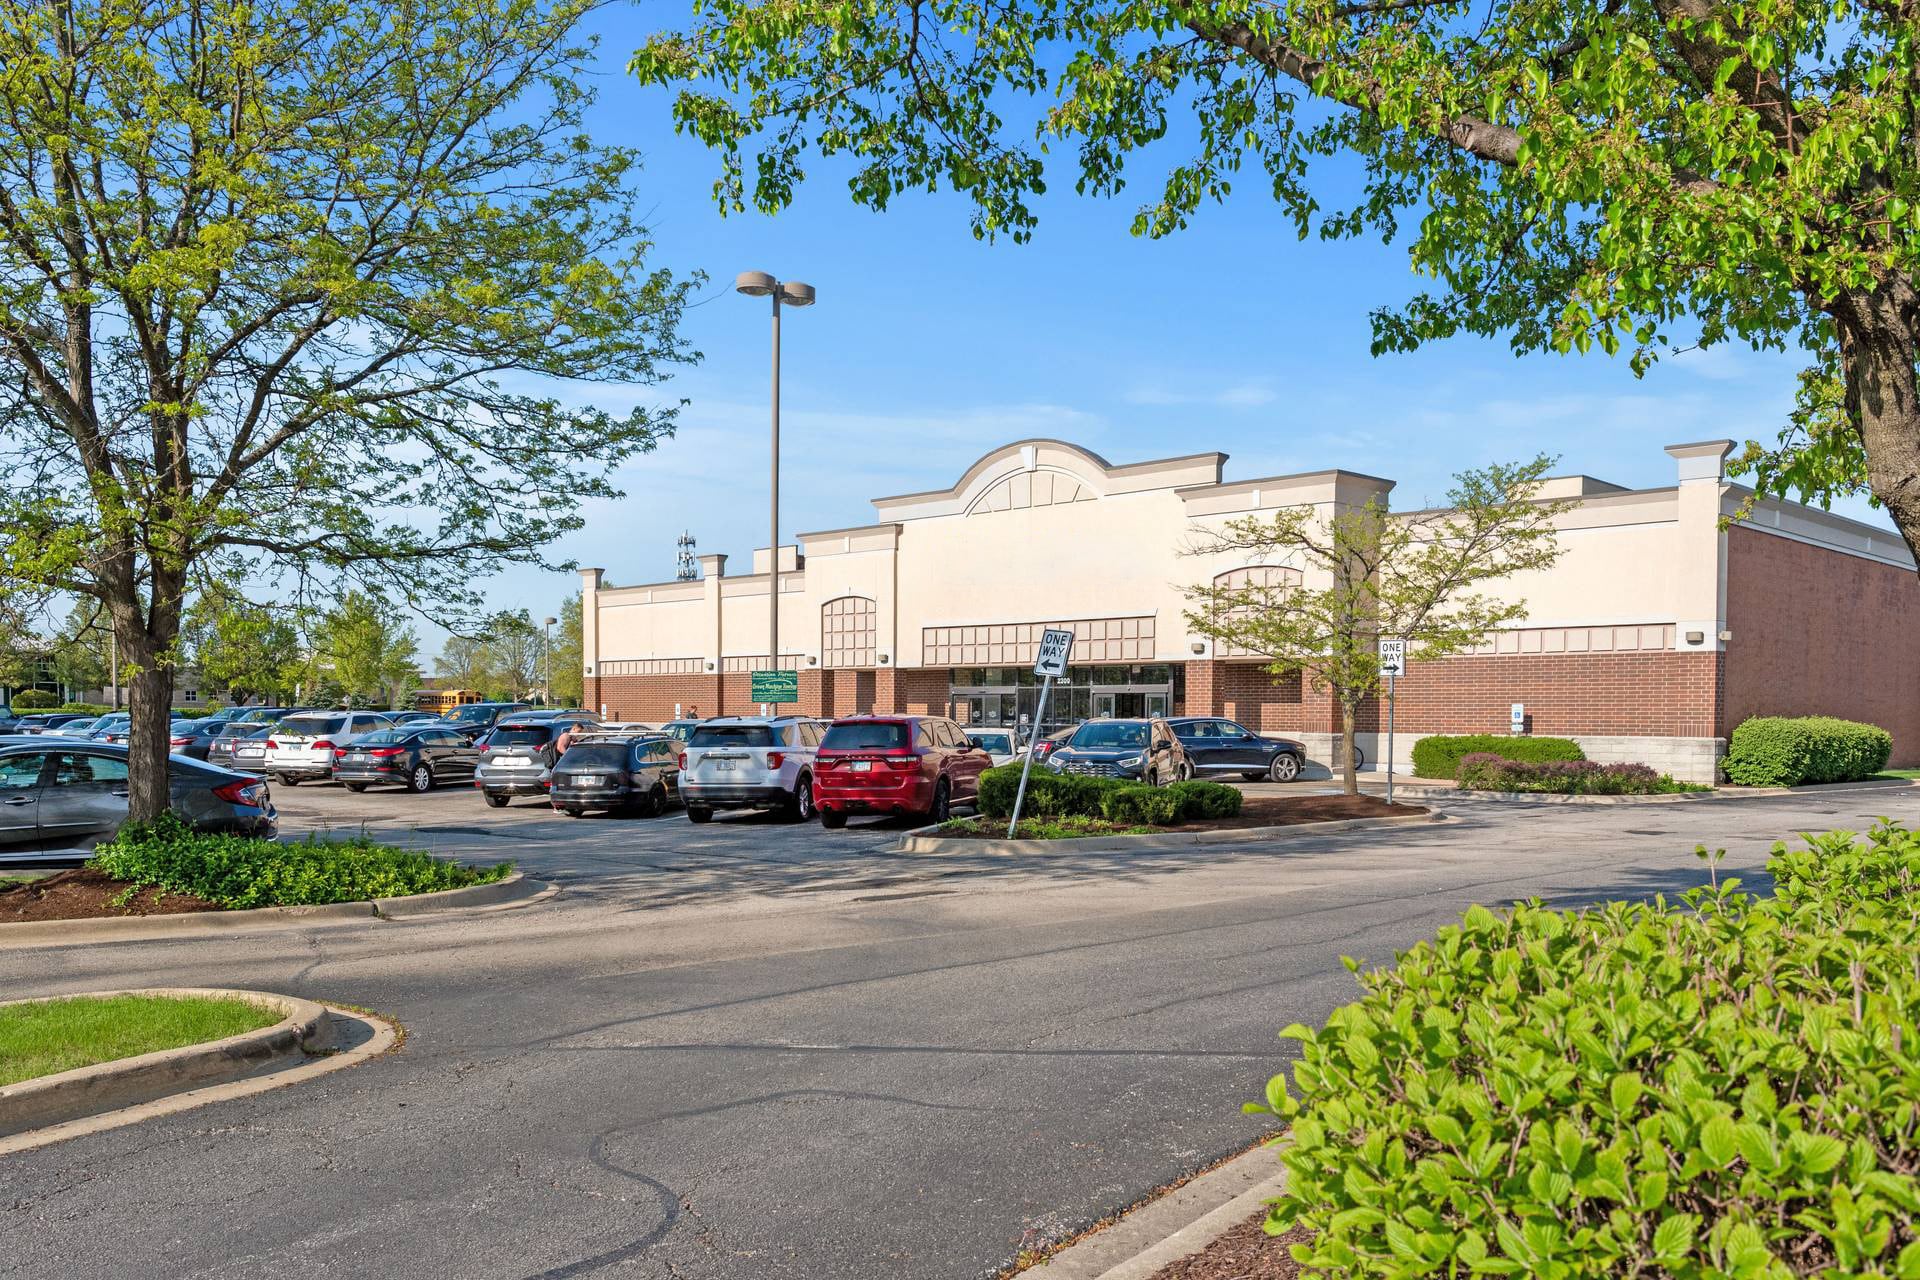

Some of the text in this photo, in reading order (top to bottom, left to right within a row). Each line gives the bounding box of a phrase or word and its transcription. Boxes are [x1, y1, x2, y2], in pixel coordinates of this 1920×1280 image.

[1045, 633, 1068, 646] ONE
[1042, 645, 1065, 658] WAY
[1382, 643, 1401, 652] ONE
[1381, 653, 1401, 662] WAY
